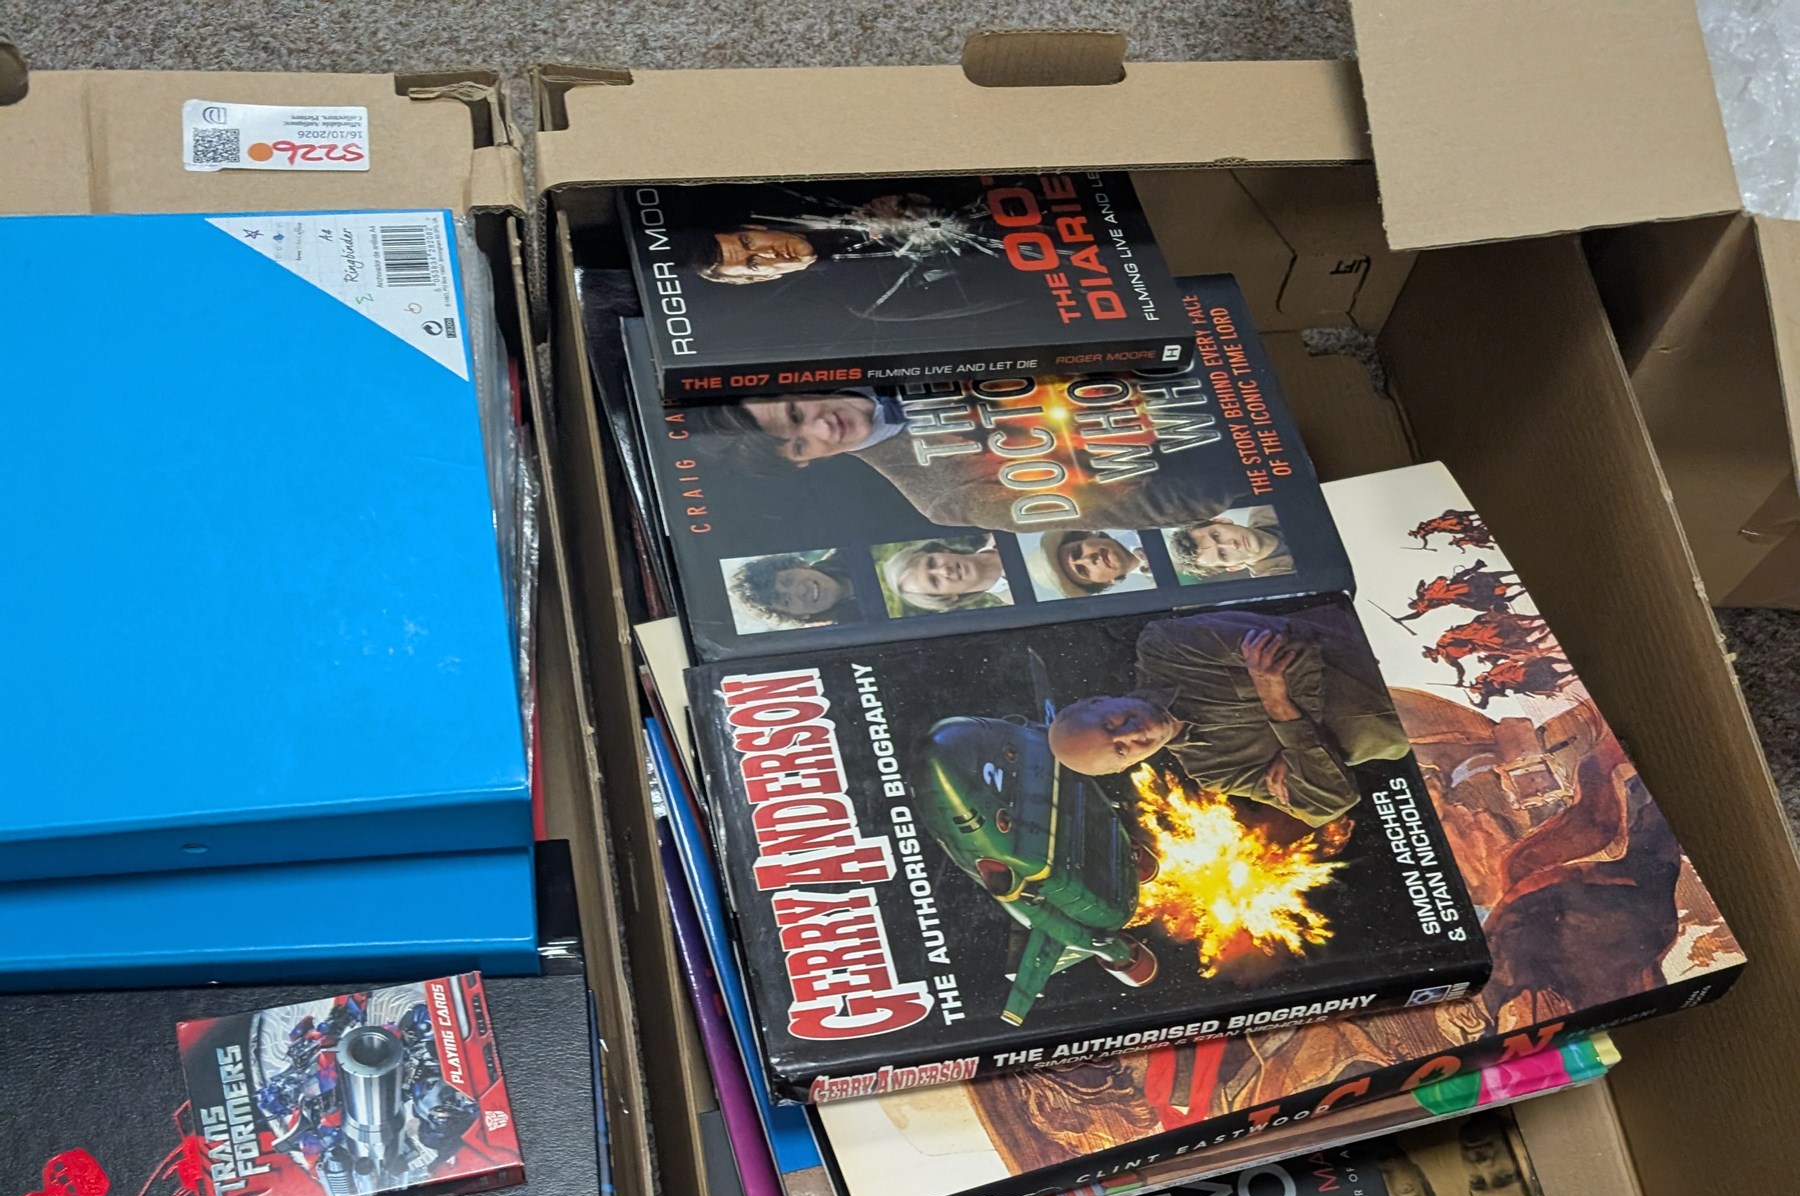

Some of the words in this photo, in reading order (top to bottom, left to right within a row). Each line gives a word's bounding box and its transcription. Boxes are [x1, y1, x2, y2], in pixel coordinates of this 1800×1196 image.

[298, 131, 363, 139] 16/10/2026
[1086, 171, 1106, 188] LE
[636, 187, 672, 251] MOO
[979, 176, 1061, 272] 00
[1094, 192, 1119, 225] AND
[340, 228, 365, 283] Ringbinder
[1039, 174, 1128, 320] DIARIE
[1108, 227, 1133, 259] LIVE
[652, 262, 698, 356] ROGER
[1044, 272, 1082, 325] THE
[1123, 261, 1160, 322] FILMING
[1181, 293, 1206, 325] FACE
[1195, 329, 1225, 367] EVERY
[1209, 306, 1239, 340] LORD
[681, 376, 722, 391] THE
[729, 374, 771, 388] 007
[777, 367, 862, 385] DIARIES
[866, 367, 921, 379] FILMING
[924, 364, 953, 375] LIVE
[955, 362, 986, 373] AND
[988, 360, 1014, 371] LET
[1015, 358, 1039, 369] DIE
[1055, 354, 1103, 364] ROGER
[1105, 350, 1157, 360] MOORE
[1223, 343, 1252, 376] TIME
[662, 399, 691, 441] CA
[1132, 362, 1223, 454] WH
[1208, 370, 1245, 419] BEHIND
[1237, 379, 1273, 426] ICONIC
[901, 377, 983, 467] THE
[1066, 376, 1160, 484] WHO
[1228, 423, 1263, 466] STORY
[1256, 429, 1285, 456] THE
[967, 376, 1081, 525] DOCTO
[1268, 459, 1293, 477] OF
[674, 458, 712, 534] CRAIG
[1246, 468, 1274, 496] THE
[850, 662, 906, 799] BIOGRAPHY
[720, 667, 898, 892] ANDERSON
[1371, 790, 1417, 866] ARCHER
[1388, 776, 1439, 867] NICHOLLS
[887, 804, 952, 965] AUTHORISED
[1401, 869, 1442, 936] SIMON
[1424, 871, 1460, 923] STAN
[1447, 926, 1468, 942] &
[770, 887, 936, 1041] GERRY
[430, 983, 454, 1029] CARDS
[932, 973, 967, 1026] THE
[441, 1030, 466, 1085] PLAYING
[809, 1073, 877, 1103] GERRY
[875, 1056, 980, 1094] ANDERSON
[993, 1047, 1045, 1068] THE
[1050, 1019, 1219, 1060] AUTHORISED
[1227, 993, 1378, 1030] BIOGRAPHY
[1032, 1053, 1094, 1069] SIMON
[1099, 1040, 1170, 1059] ARCHER
[1193, 1029, 1240, 1043] STAN
[1245, 1014, 1329, 1034] NICHOLLS
[215, 1044, 271, 1179] FORMERS
[1075, 1152, 1161, 1184] CLINT
[1175, 1103, 1331, 1156] EASTWOOD
[1307, 1151, 1341, 1194] MA
[1347, 1167, 1360, 1183] OF
